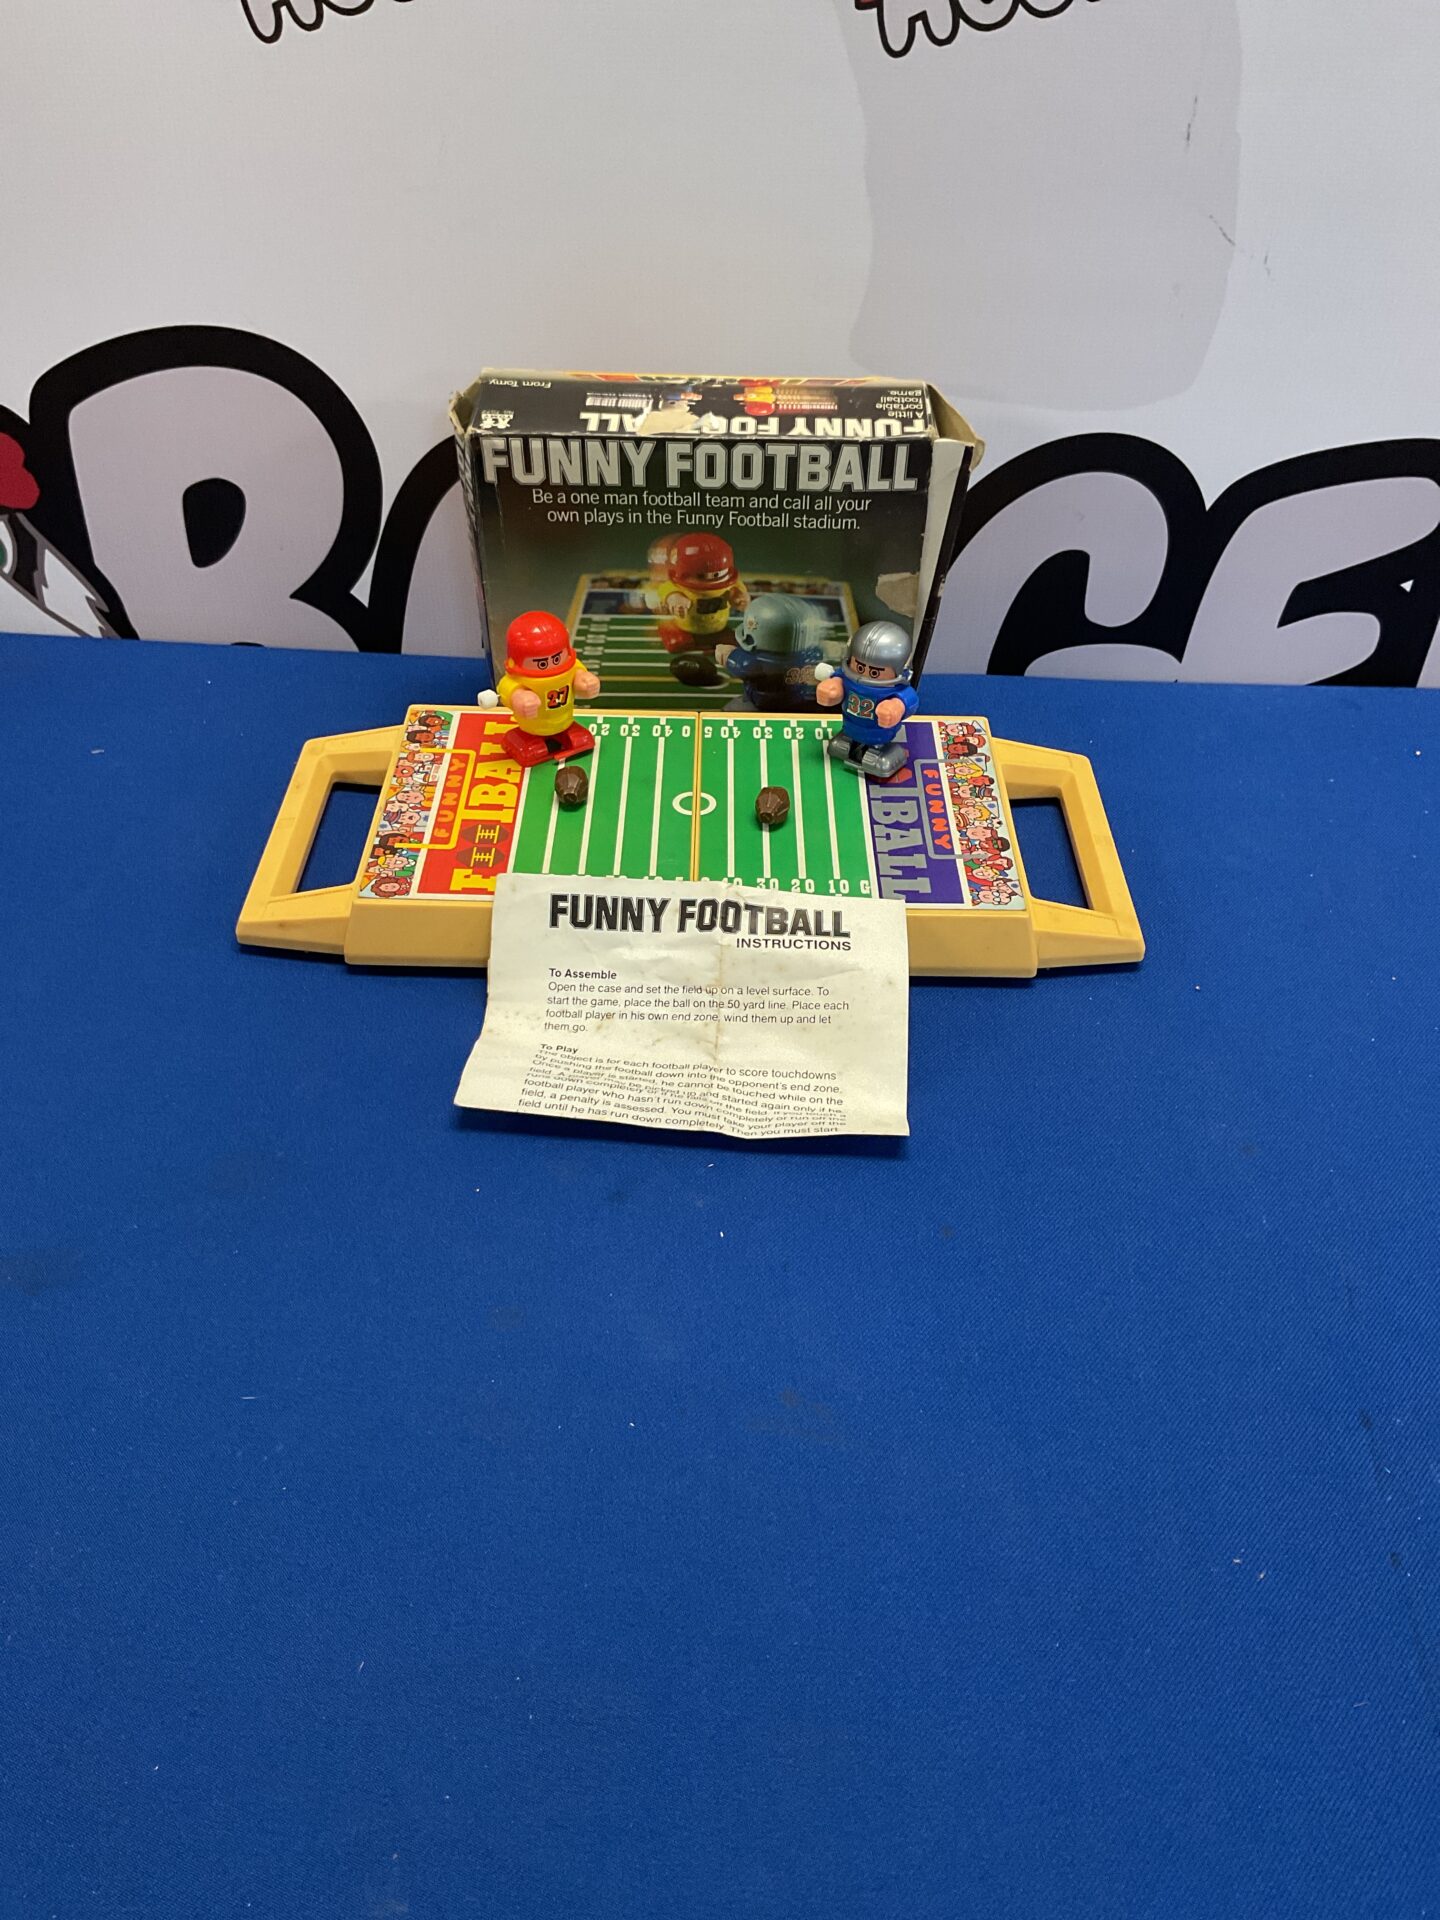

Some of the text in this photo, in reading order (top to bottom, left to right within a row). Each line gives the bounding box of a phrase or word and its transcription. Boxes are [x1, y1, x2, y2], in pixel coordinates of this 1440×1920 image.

[489, 379, 552, 389] From Tomy
[890, 389, 922, 397] game.
[876, 402, 923, 411] portable
[788, 417, 925, 438] FUNNY
[480, 437, 918, 492] FUNNY FOOTBALL
[532, 488, 872, 514] Be a one man football team and call all your
[547, 508, 860, 530] own plays in the Funny Football stadium.
[547, 685, 569, 709] 27
[846, 690, 875, 720] 32
[588, 723, 610, 736] 20
[620, 724, 640, 736] 30
[652, 724, 673, 737] 40
[721, 726, 741, 738] 40
[753, 726, 773, 739] 30
[783, 727, 804, 739] 20
[434, 758, 466, 838] FUNNY
[923, 769, 952, 850] FUNNY
[791, 879, 815, 893] 20
[828, 879, 850, 894] 10
[860, 879, 871, 894] G
[549, 893, 851, 939] FUNNY FOOTBALL
[736, 938, 852, 951] INSTRUCTIONS
[549, 968, 617, 980] To Assemble
[548, 981, 829, 996] Open the case and set the field up on a level surface. To
[547, 996, 569, 1005] start
[572, 996, 588, 1006] the
[590, 998, 621, 1008] game,
[624, 998, 652, 1008] place
[654, 998, 670, 1008] the
[672, 998, 690, 1008] ball
[693, 999, 706, 1008] on
[709, 999, 724, 1008] the
[727, 1000, 740, 1009] 50
[743, 1000, 765, 1011] yard
[792, 1001, 820, 1010] Place
[823, 1001, 849, 1010] each
[545, 1009, 832, 1025] football player in his own end zone, wind them up and let
[544, 1022, 588, 1033] them go.
[541, 1043, 579, 1054] To Play
[560, 1053, 592, 1063] object
[623, 1060, 649, 1069] each
[652, 1062, 690, 1070] football
[693, 1063, 723, 1074] player
[726, 1067, 736, 1076] to
[739, 1069, 769, 1077] score
[771, 1069, 837, 1080] touchdowns
[550, 1058, 592, 1070] pushing
[614, 1066, 653, 1077] football
[709, 1074, 726, 1082] the
[728, 1079, 788, 1090] opponent's
[790, 1083, 811, 1092] end
[532, 1060, 561, 1069] Once
[716, 1083, 730, 1091] be
[732, 1087, 776, 1100] touched
[779, 1093, 806, 1102] while
[826, 1097, 844, 1106] the
[524, 1079, 564, 1090] football
[566, 1085, 600, 1094] player
[602, 1091, 625, 1100] who
[627, 1094, 660, 1103] hasn't
[684, 1101, 713, 1111] down
[521, 1088, 546, 1099] field,
[560, 1093, 600, 1106] penalty
[671, 1107, 692, 1115] You
[694, 1110, 720, 1120] must
[724, 1117, 745, 1128] take
[518, 1099, 542, 1108] field
[544, 1102, 568, 1111] until
[570, 1105, 585, 1114] he
[587, 1108, 608, 1116] has
[610, 1111, 629, 1119] run
[631, 1113, 662, 1123] down
[730, 1127, 757, 1136] Then
